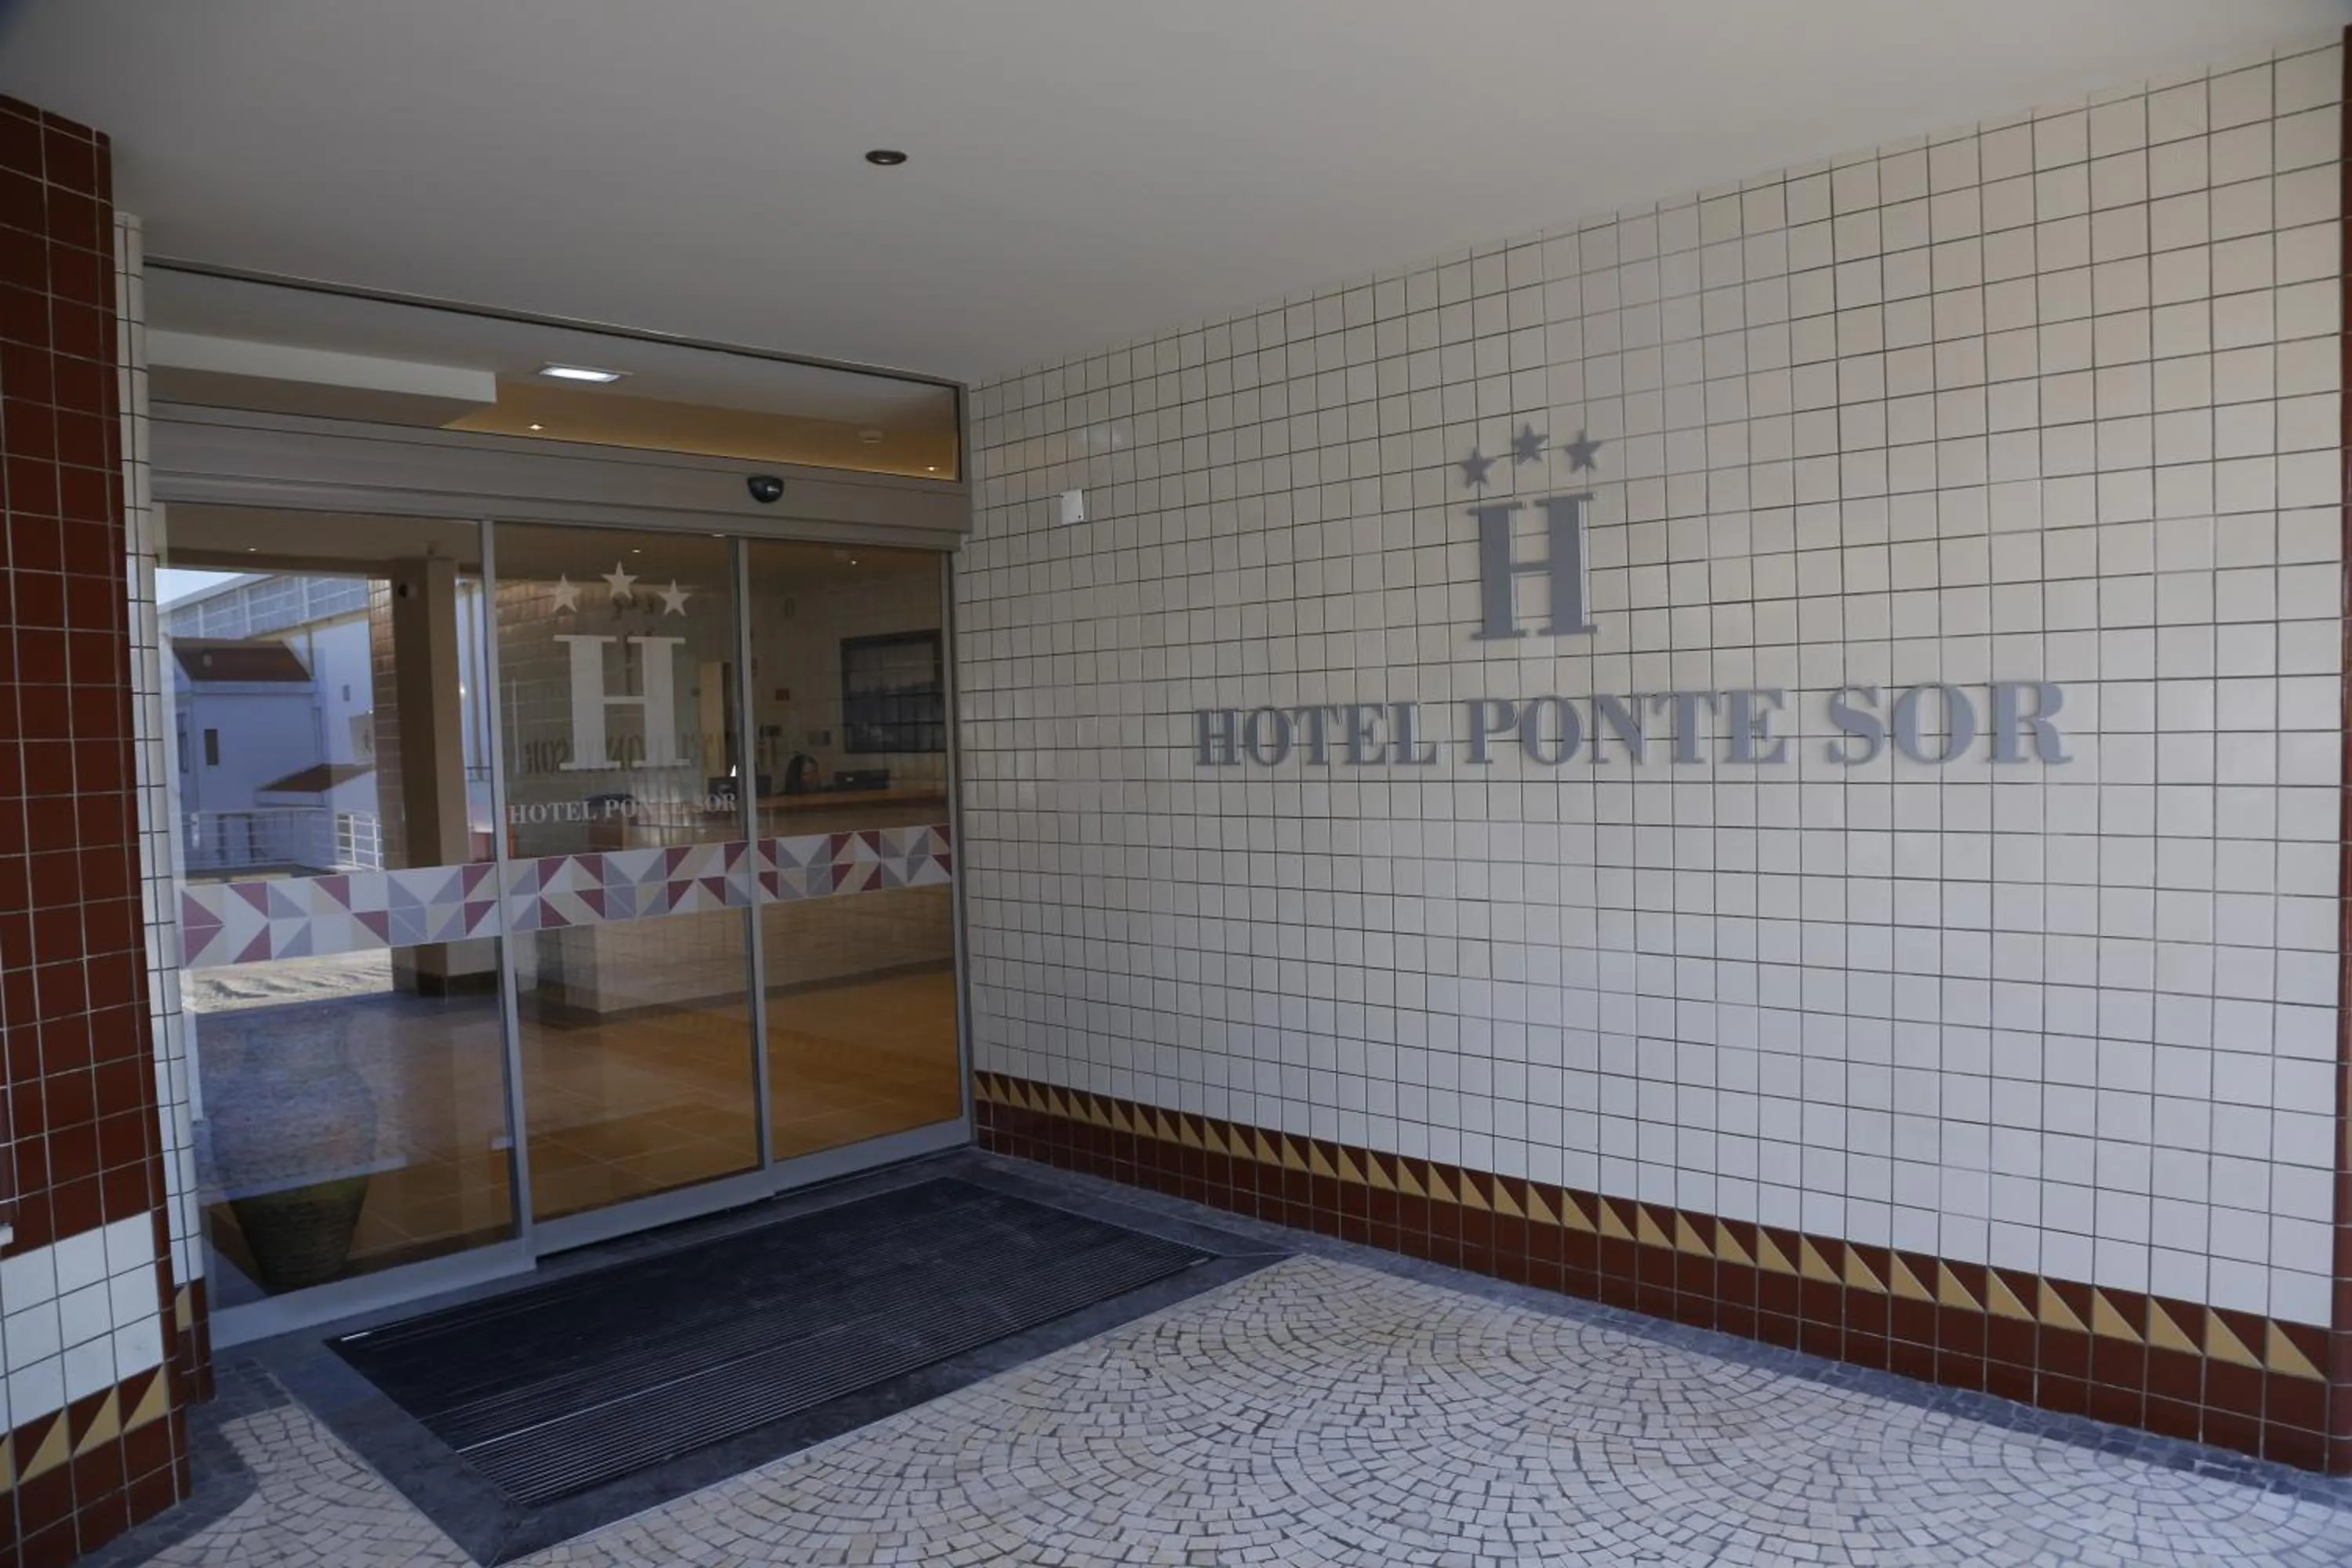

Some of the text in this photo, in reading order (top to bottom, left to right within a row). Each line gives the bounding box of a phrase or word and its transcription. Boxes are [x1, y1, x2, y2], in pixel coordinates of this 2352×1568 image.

[1467, 492, 1598, 641] H
[554, 634, 691, 771] H
[1195, 681, 2072, 767] HOTEL PONTE SOR
[510, 800, 597, 824] HOTEL
